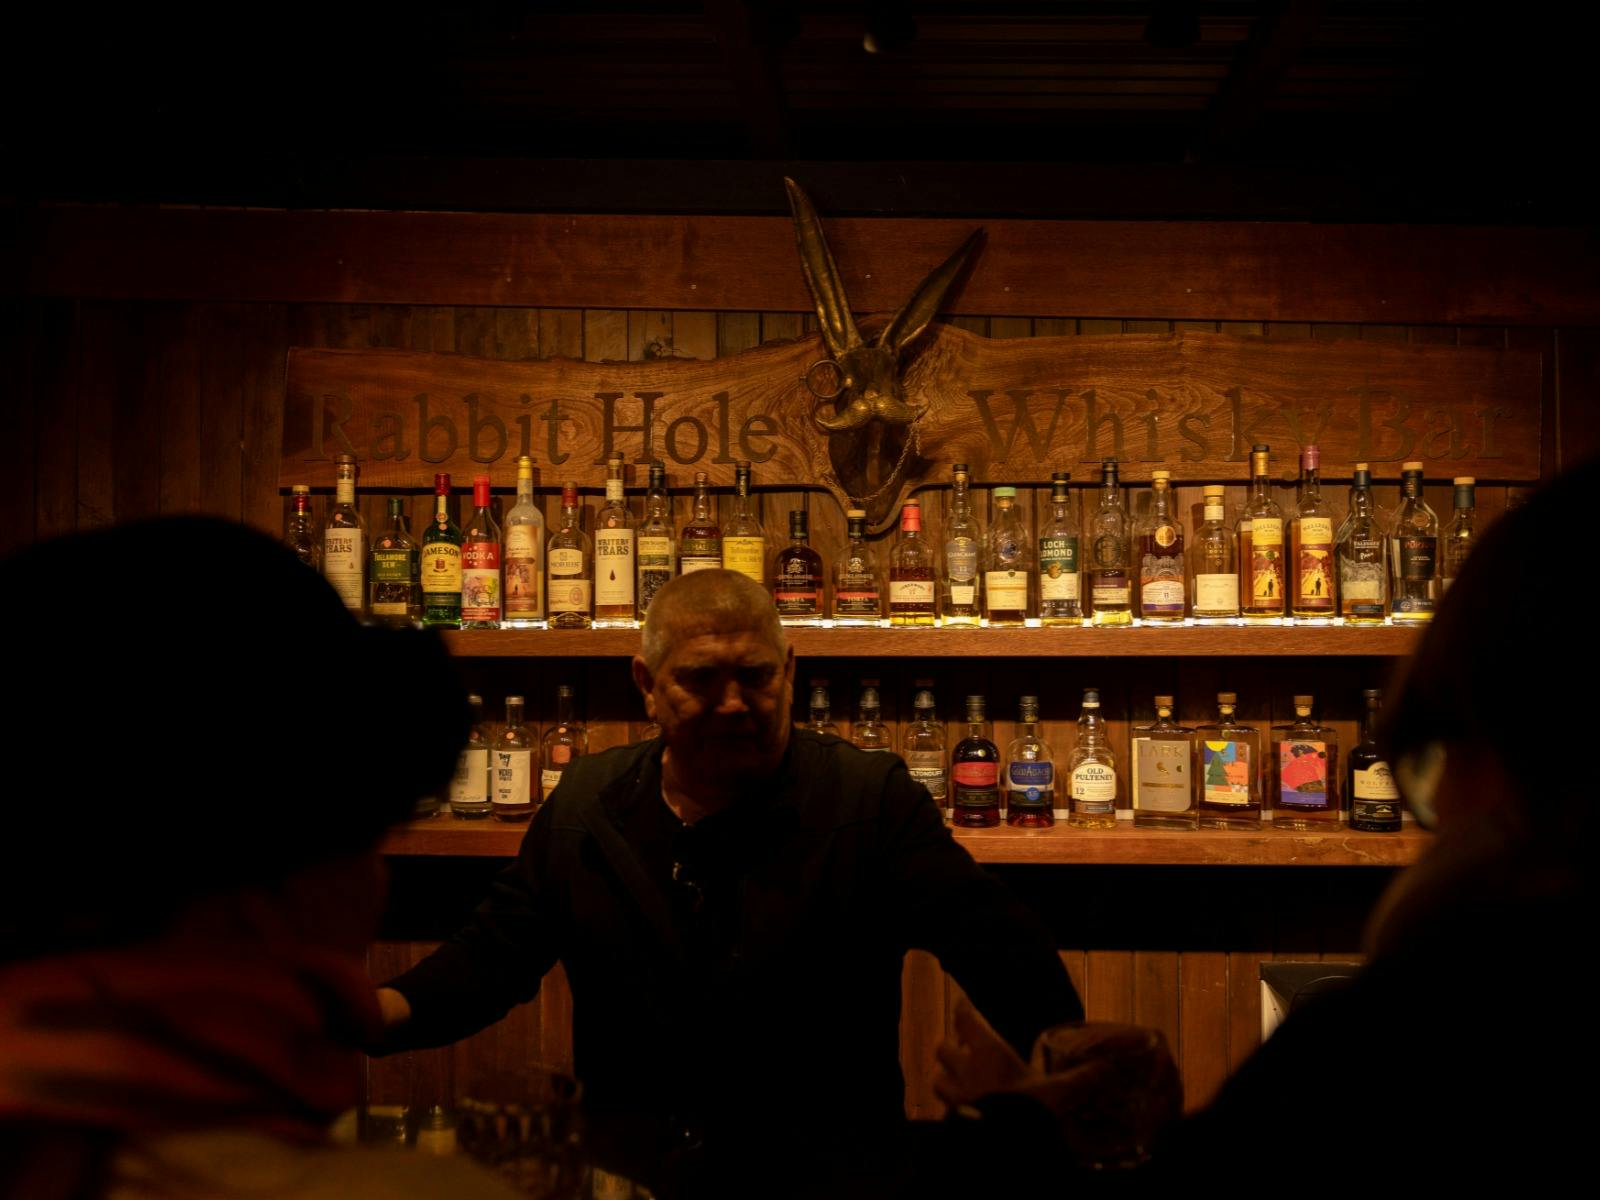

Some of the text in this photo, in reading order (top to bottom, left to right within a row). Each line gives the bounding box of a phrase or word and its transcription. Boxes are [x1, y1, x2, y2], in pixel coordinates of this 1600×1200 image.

[303, 387, 1513, 488] Rabbit Hole Whisky Bar
[1043, 540, 1065, 549] LOCH
[423, 547, 459, 557] JAMESON
[598, 545, 629, 556] TEARS
[462, 551, 494, 561] VODKA
